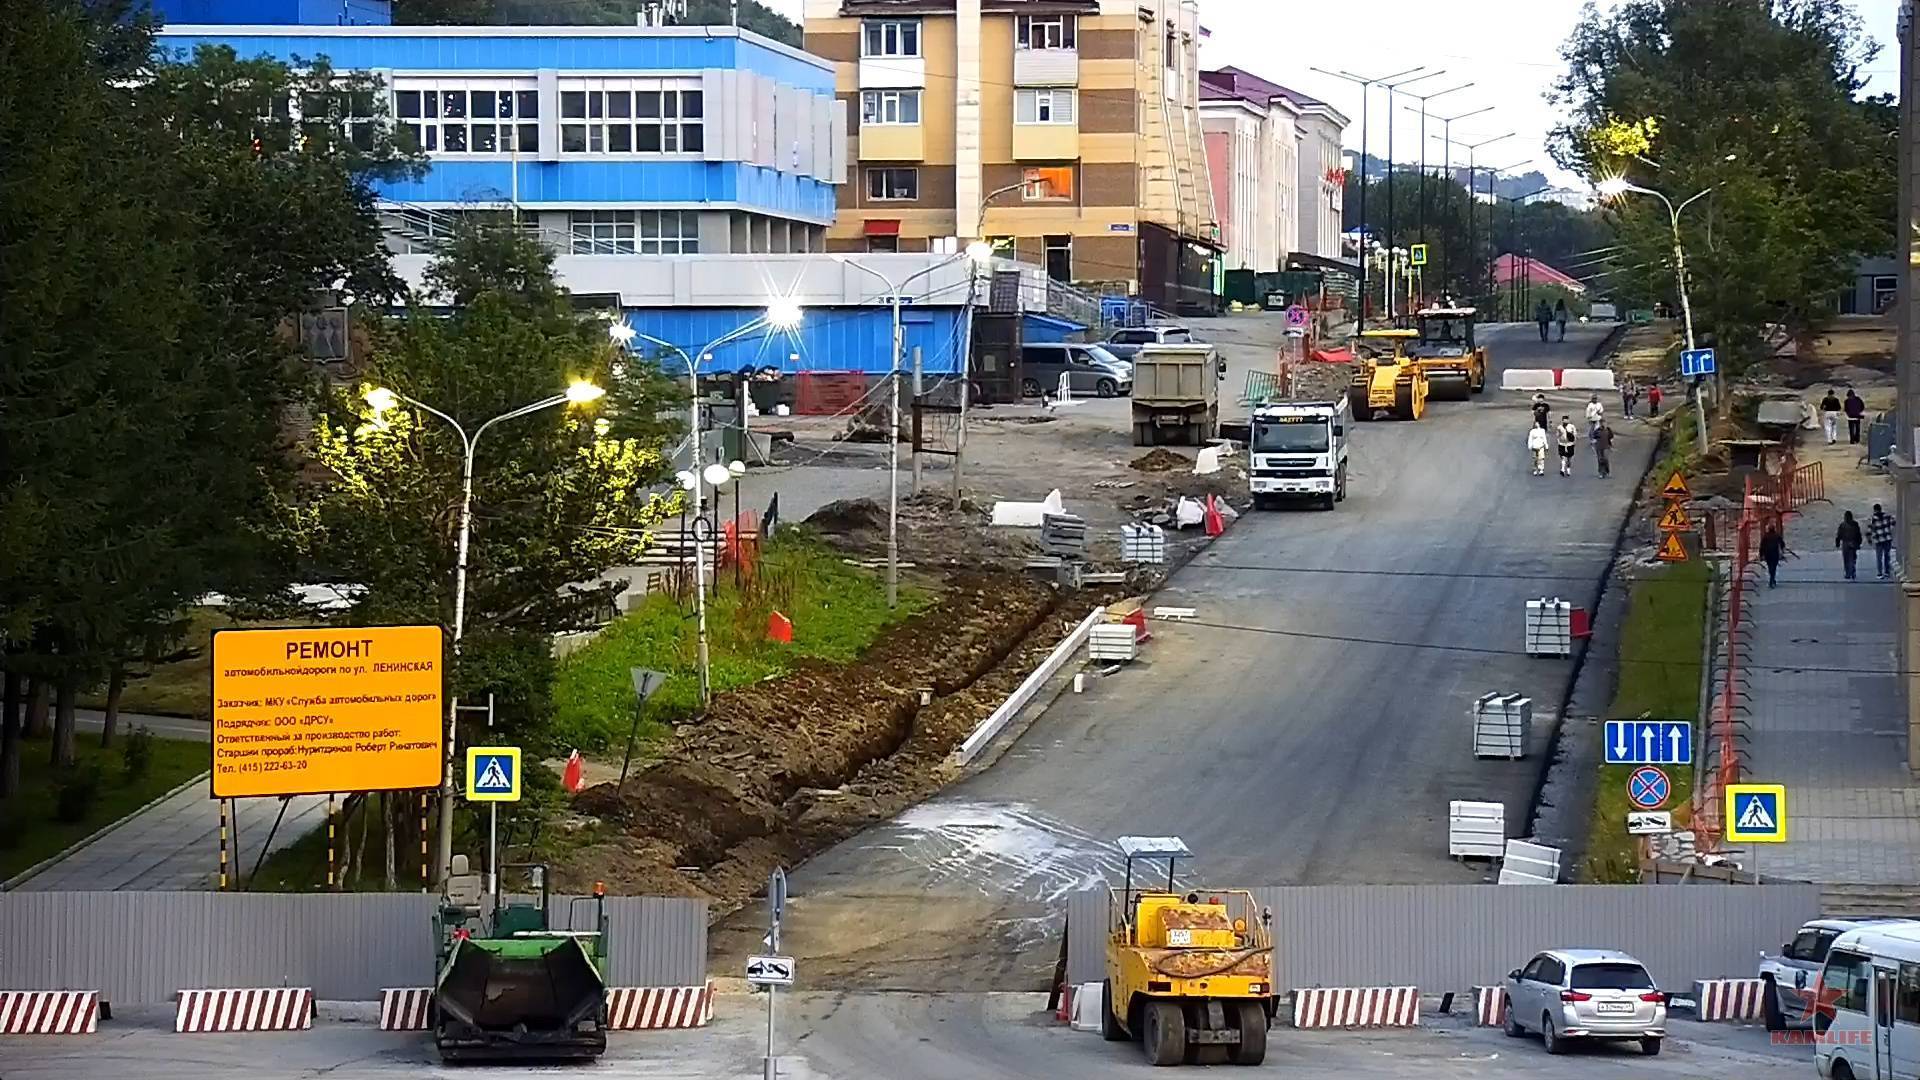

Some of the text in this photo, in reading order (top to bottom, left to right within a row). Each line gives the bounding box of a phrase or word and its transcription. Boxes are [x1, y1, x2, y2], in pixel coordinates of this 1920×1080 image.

[286, 639, 373, 660] РЕМОНТ
[339, 666, 352, 674] по
[354, 665, 367, 675] ул.
[373, 661, 433, 673] ЛЕНИНСКАЯ
[265, 697, 285, 706] МКУ
[287, 695, 326, 708] «Служба
[329, 693, 402, 704] автомобильных
[216, 715, 333, 729] Подрядчик: ООО «ДРСУ»
[216, 728, 401, 744] Ответственный за производство работ:
[217, 746, 259, 759] Старший
[355, 741, 387, 753] Роберт
[389, 740, 438, 751] Ринатович
[217, 763, 236, 773] Тел.
